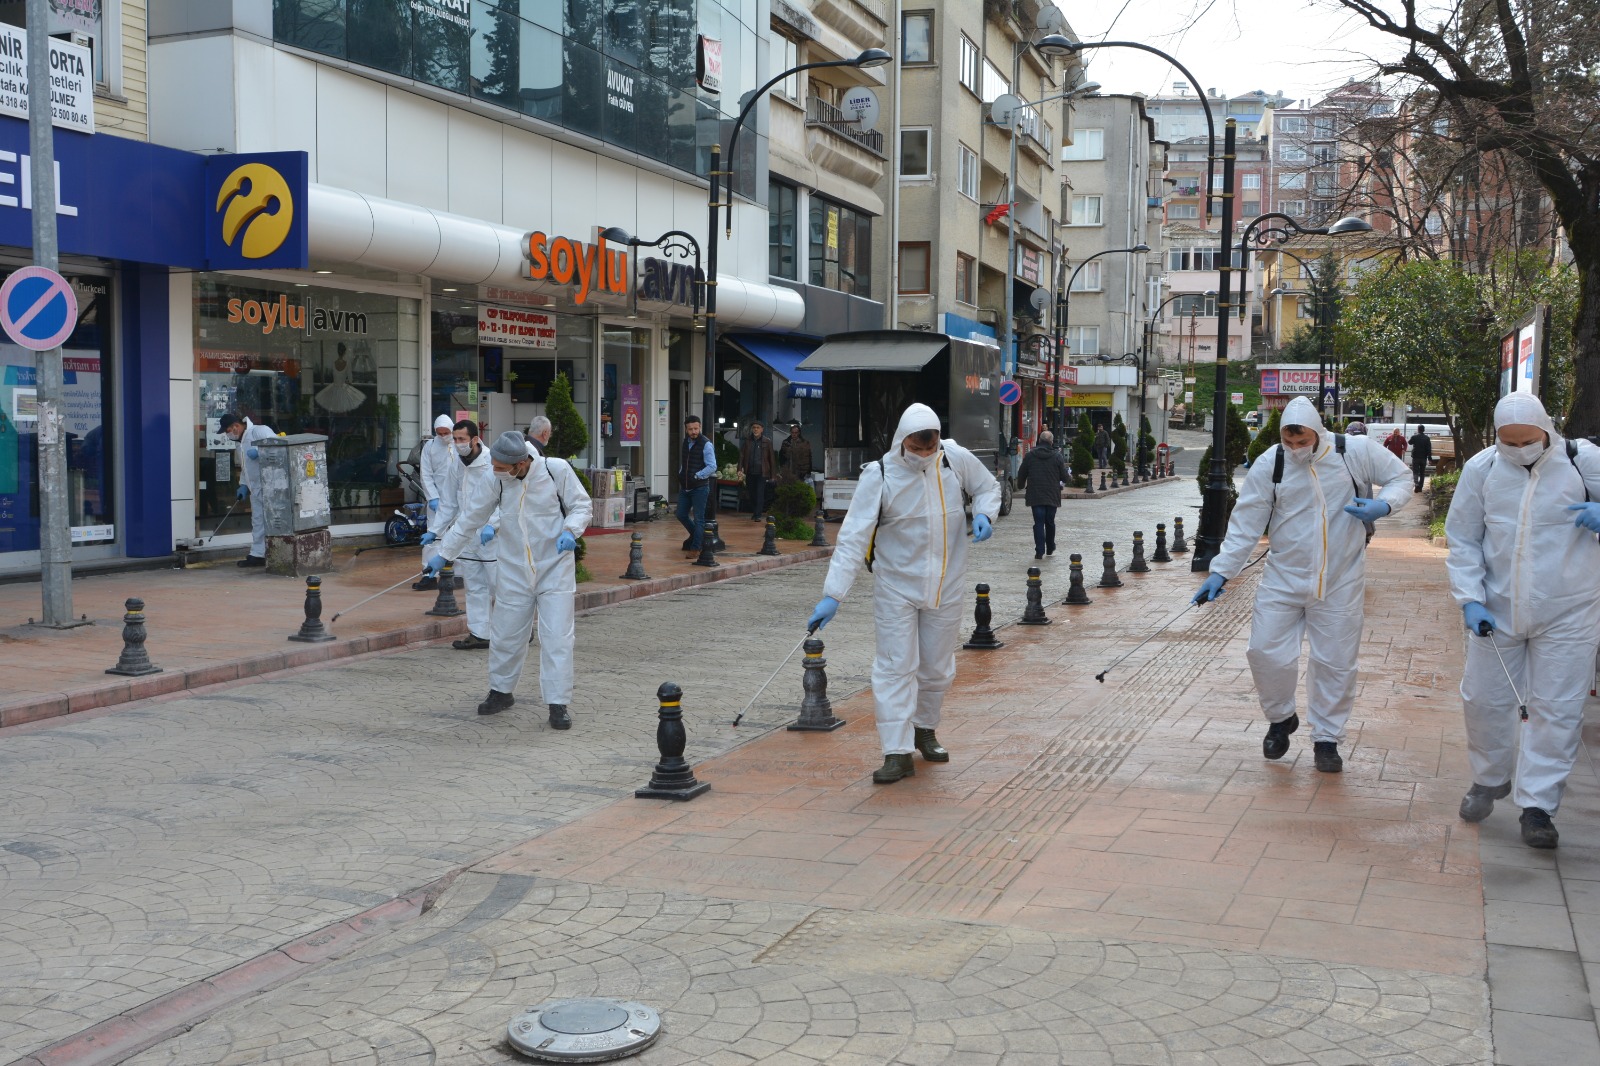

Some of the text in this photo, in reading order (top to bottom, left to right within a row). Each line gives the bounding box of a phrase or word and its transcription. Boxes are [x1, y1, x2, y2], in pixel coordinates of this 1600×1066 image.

[49, 48, 85, 77] ORTA
[607, 69, 634, 98] AVUKAT
[5, 96, 18, 108] 318
[58, 107, 70, 121] 500
[71, 111, 79, 123] 80
[80, 114, 88, 125] 45
[523, 226, 627, 305] soylu
[79, 282, 107, 295] Turkcell
[227, 294, 368, 335] soylu avm
[1282, 384, 1297, 392] ÖZEL
[1298, 383, 1320, 392] GİRESU
[625, 413, 638, 430] 50
